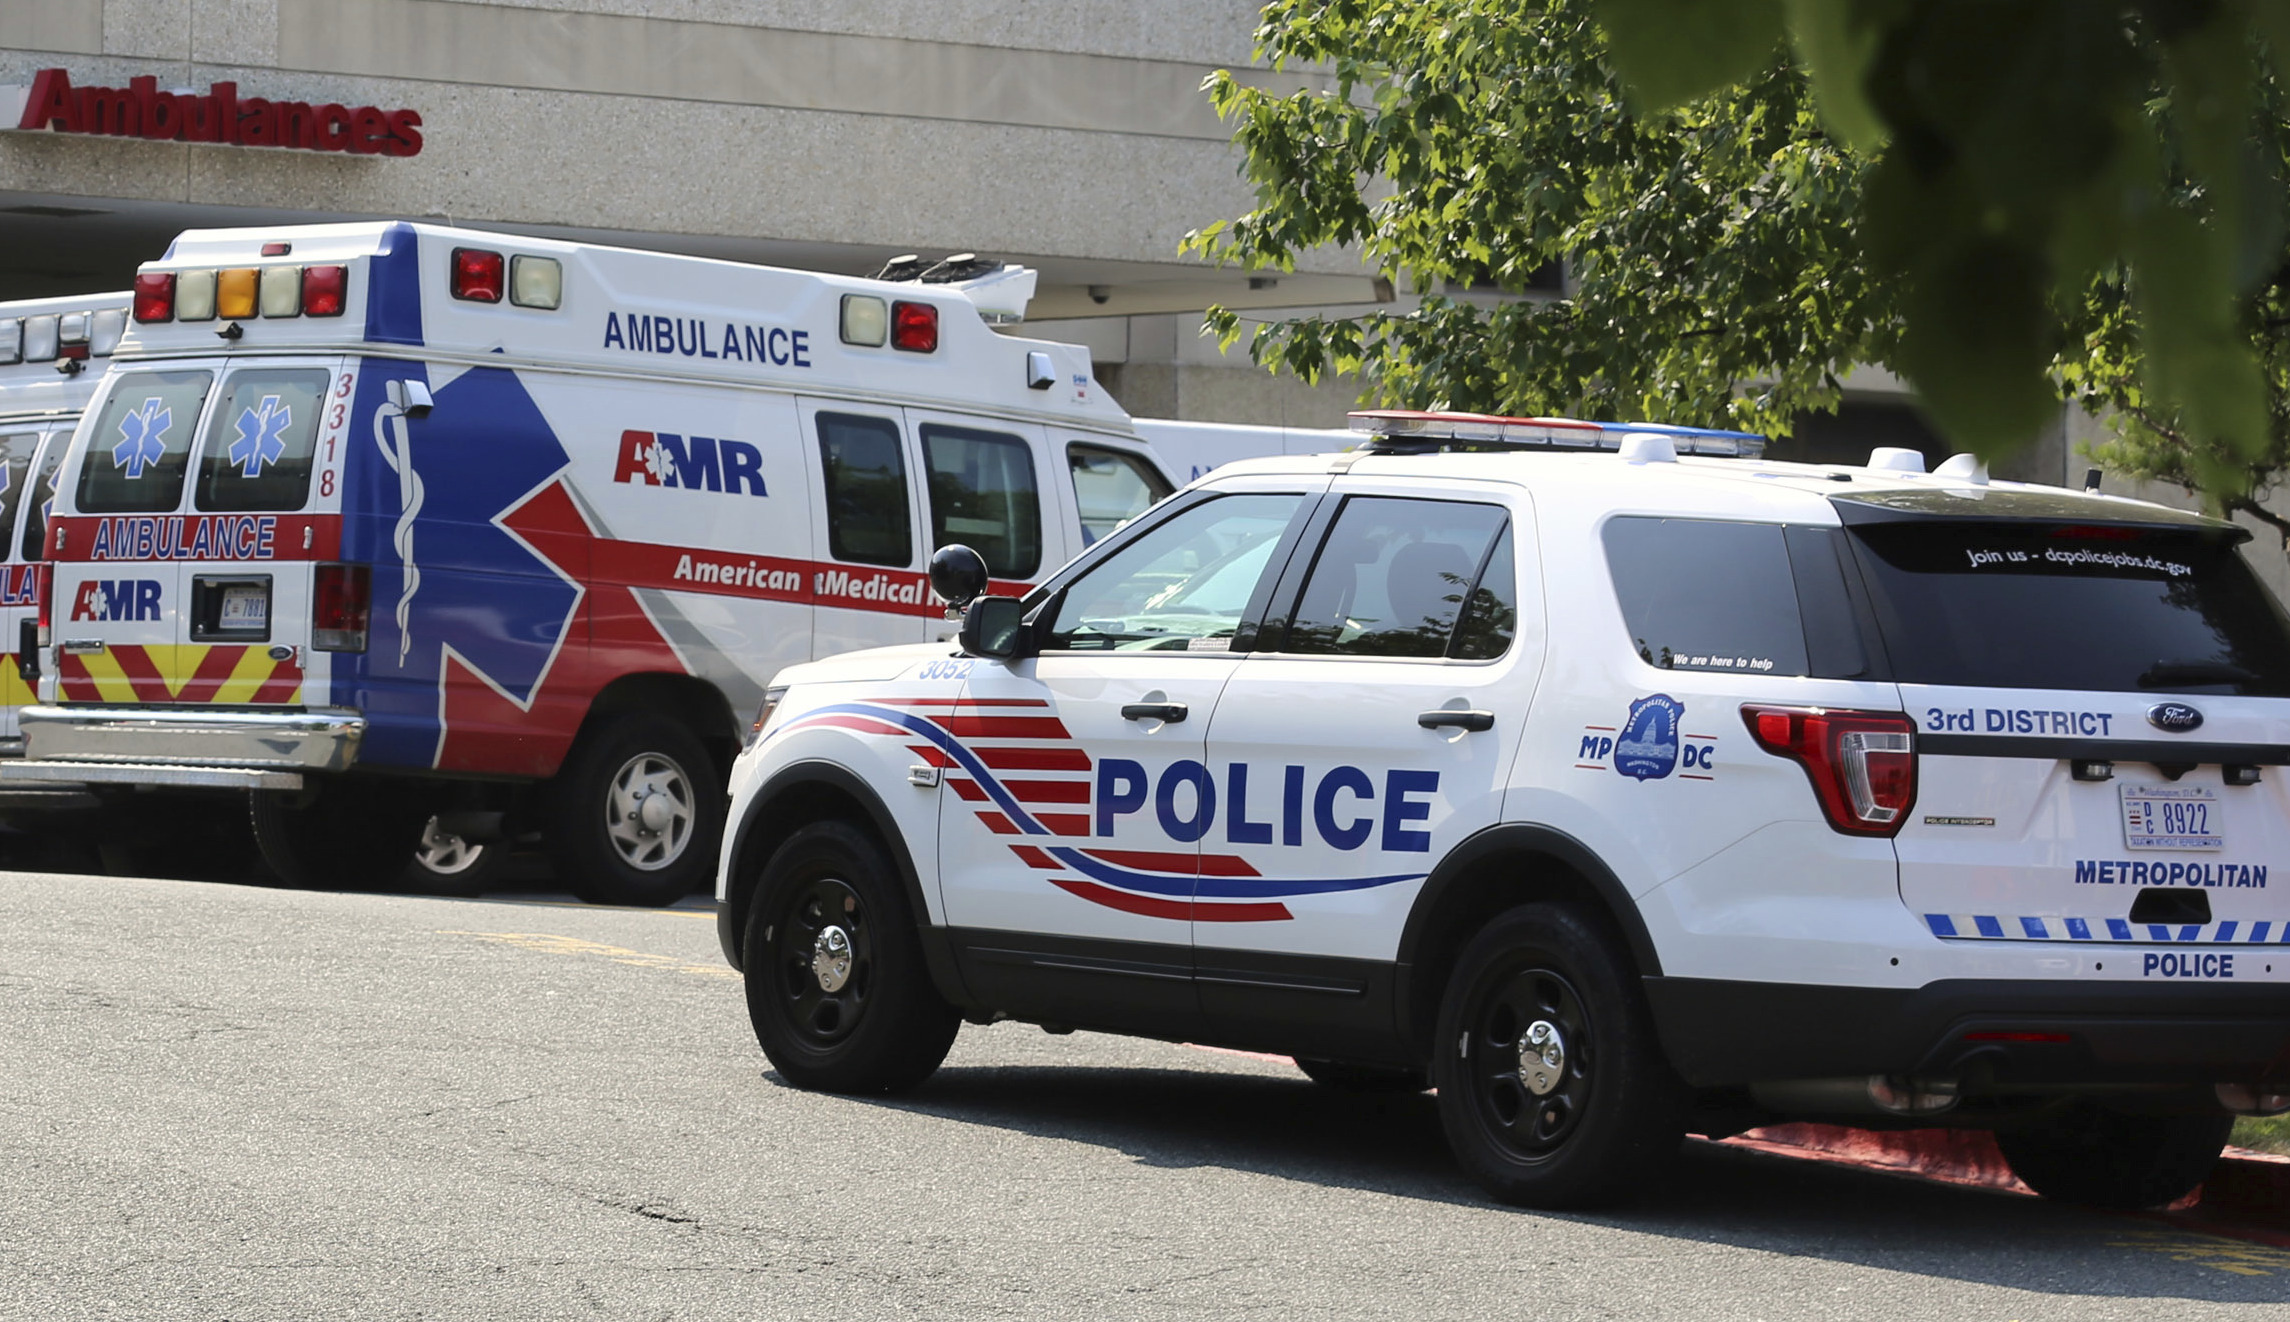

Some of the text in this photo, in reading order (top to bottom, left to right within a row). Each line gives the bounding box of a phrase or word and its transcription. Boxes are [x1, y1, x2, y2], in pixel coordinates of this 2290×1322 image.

[20, 67, 424, 158] Ambulances
[603, 311, 811, 368] AMBULANCE
[614, 429, 768, 498] AMR
[91, 516, 277, 560] AMBULANCE
[1966, 549, 2003, 567] Join
[2007, 551, 2027, 562] us
[2045, 548, 2191, 576] dcpolicejobs.dc.gov
[674, 554, 801, 593] American
[824, 570, 926, 605] Medical
[70, 579, 162, 621] AMR
[919, 660, 974, 680] 3052
[1673, 654, 1774, 671] We are here to help
[1926, 708, 2113, 736] 3rd DISTRICT
[2162, 706, 2195, 725] Ford
[1578, 735, 1613, 760] MP
[1682, 744, 1715, 770] DC
[1096, 757, 1441, 853] POLICE
[2163, 802, 2210, 835] 8922
[2075, 860, 2268, 889] METROPOLITAN
[2143, 953, 2234, 978] POLICE
